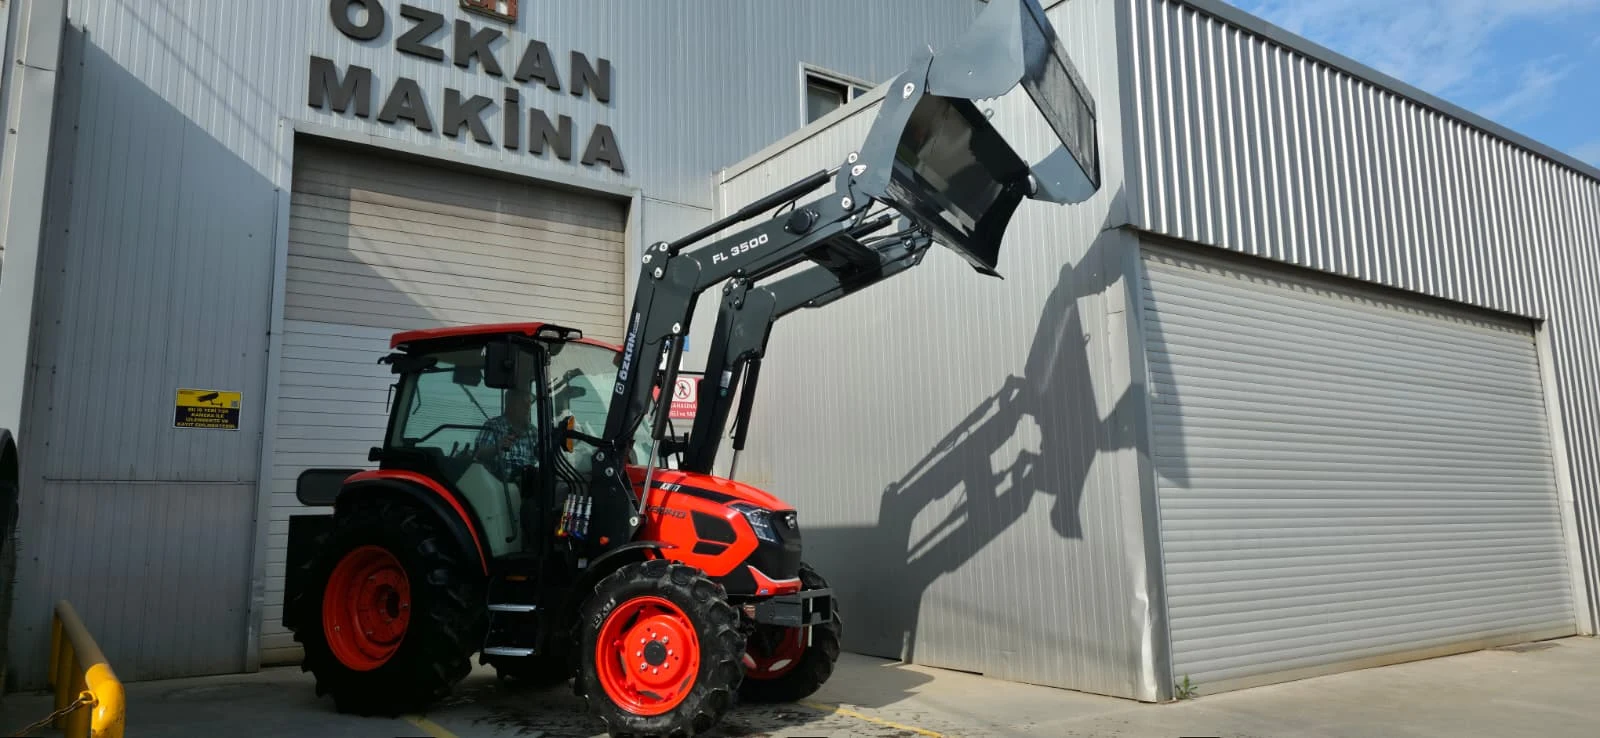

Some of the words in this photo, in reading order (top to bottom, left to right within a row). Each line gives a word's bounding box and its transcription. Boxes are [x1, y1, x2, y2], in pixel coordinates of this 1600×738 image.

[308, 55, 625, 173] MAKİNA
[712, 252, 728, 265] FL
[730, 233, 769, 256] 3500
